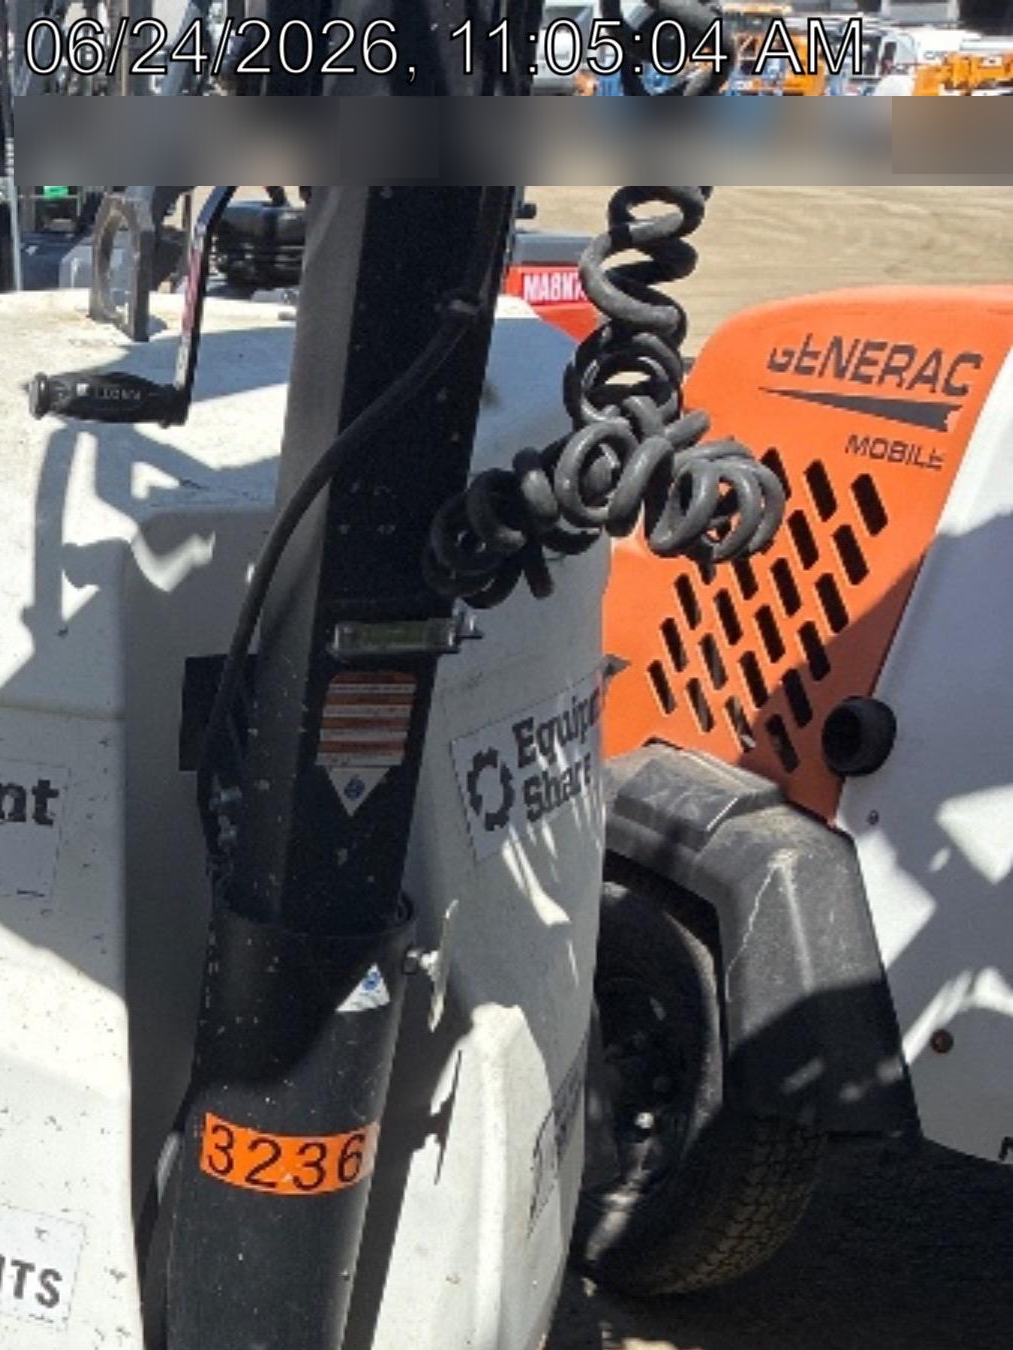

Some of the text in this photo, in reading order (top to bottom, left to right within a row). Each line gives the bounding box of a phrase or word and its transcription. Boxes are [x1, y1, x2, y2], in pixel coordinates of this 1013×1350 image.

[766, 332, 984, 397] GENERAC
[845, 434, 945, 471] MOBILE
[208, 1124, 366, 1191] 3236
